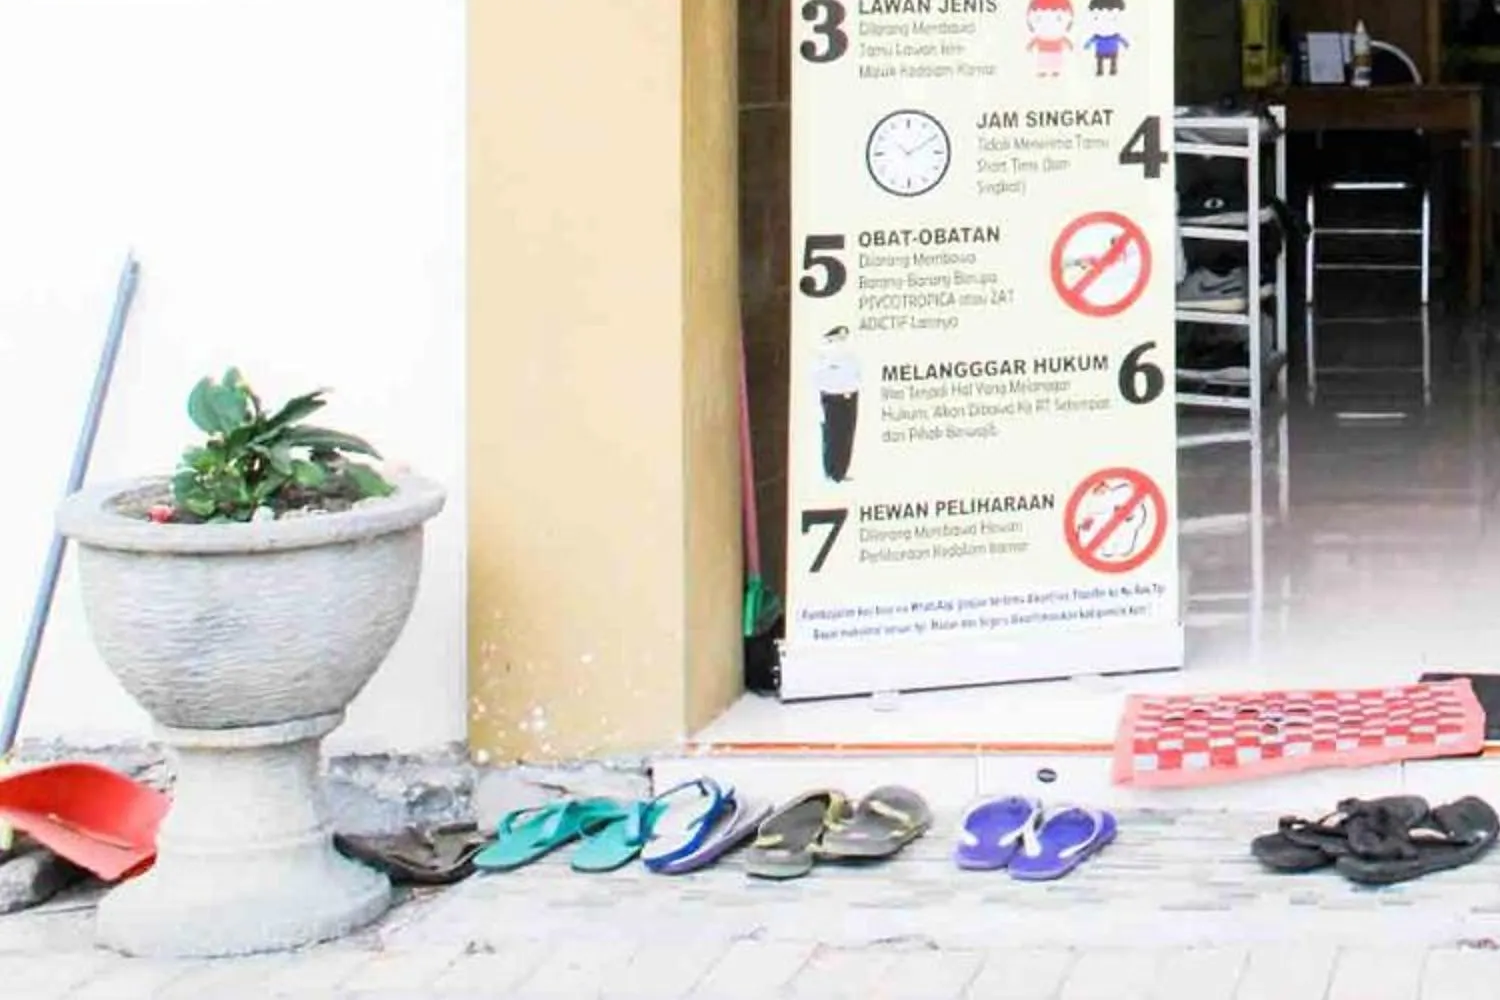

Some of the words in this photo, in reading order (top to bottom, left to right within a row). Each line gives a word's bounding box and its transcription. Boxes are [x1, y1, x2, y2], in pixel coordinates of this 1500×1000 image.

[976, 112, 1019, 129] JAM
[1026, 109, 1114, 128] SINGKAT
[1119, 116, 1169, 179] 4
[858, 226, 1000, 248] OBAT-OBATAN
[799, 234, 847, 299] 5
[1033, 355, 1109, 376] HUKUM
[1118, 341, 1165, 405] 6
[859, 501, 928, 522] HEWAN
[936, 494, 1055, 517] PELIHARAAN
[801, 508, 849, 573] 7
